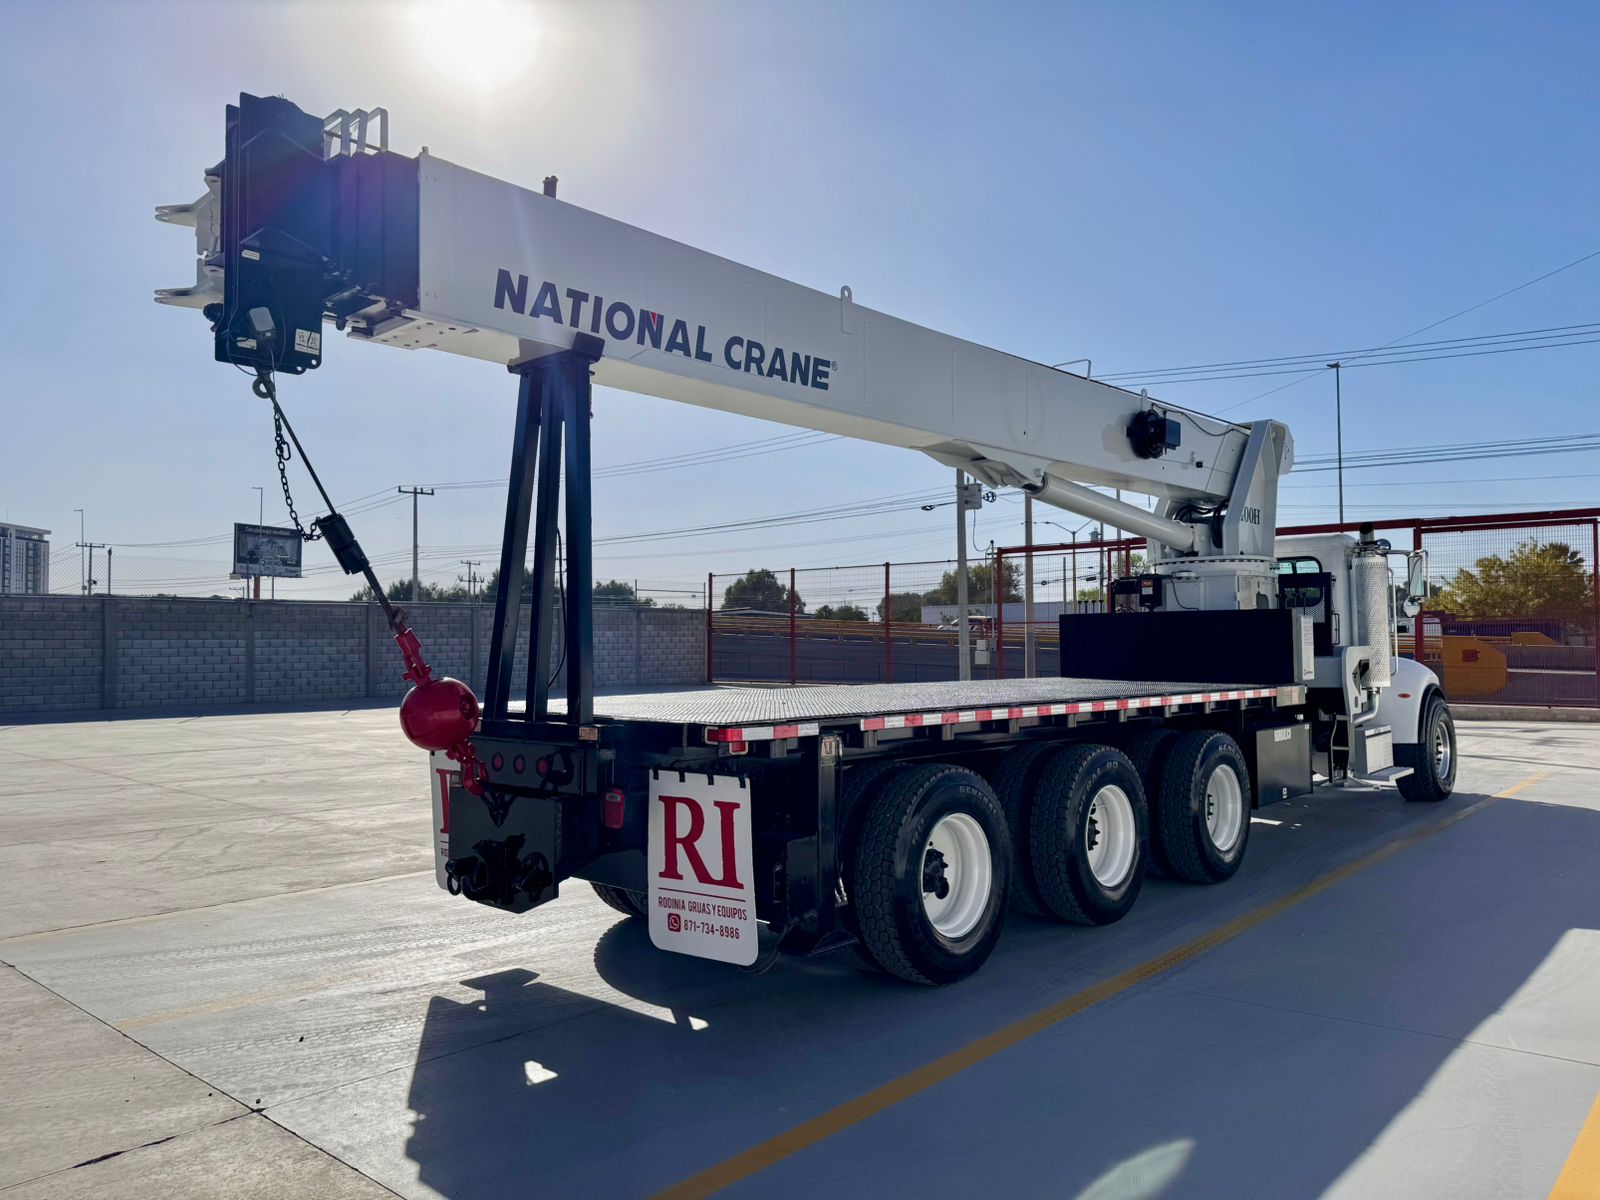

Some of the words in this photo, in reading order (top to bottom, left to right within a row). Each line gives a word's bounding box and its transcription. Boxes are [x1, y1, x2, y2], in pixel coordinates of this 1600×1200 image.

[493, 268, 713, 363] NATIONAL
[658, 795, 744, 889] RI
[658, 896, 686, 911] RODINIA
[687, 900, 711, 915] GRUAS
[711, 904, 718, 916] Y
[717, 905, 748, 921] EQUIPOS
[683, 919, 740, 939] 871-734-8986
